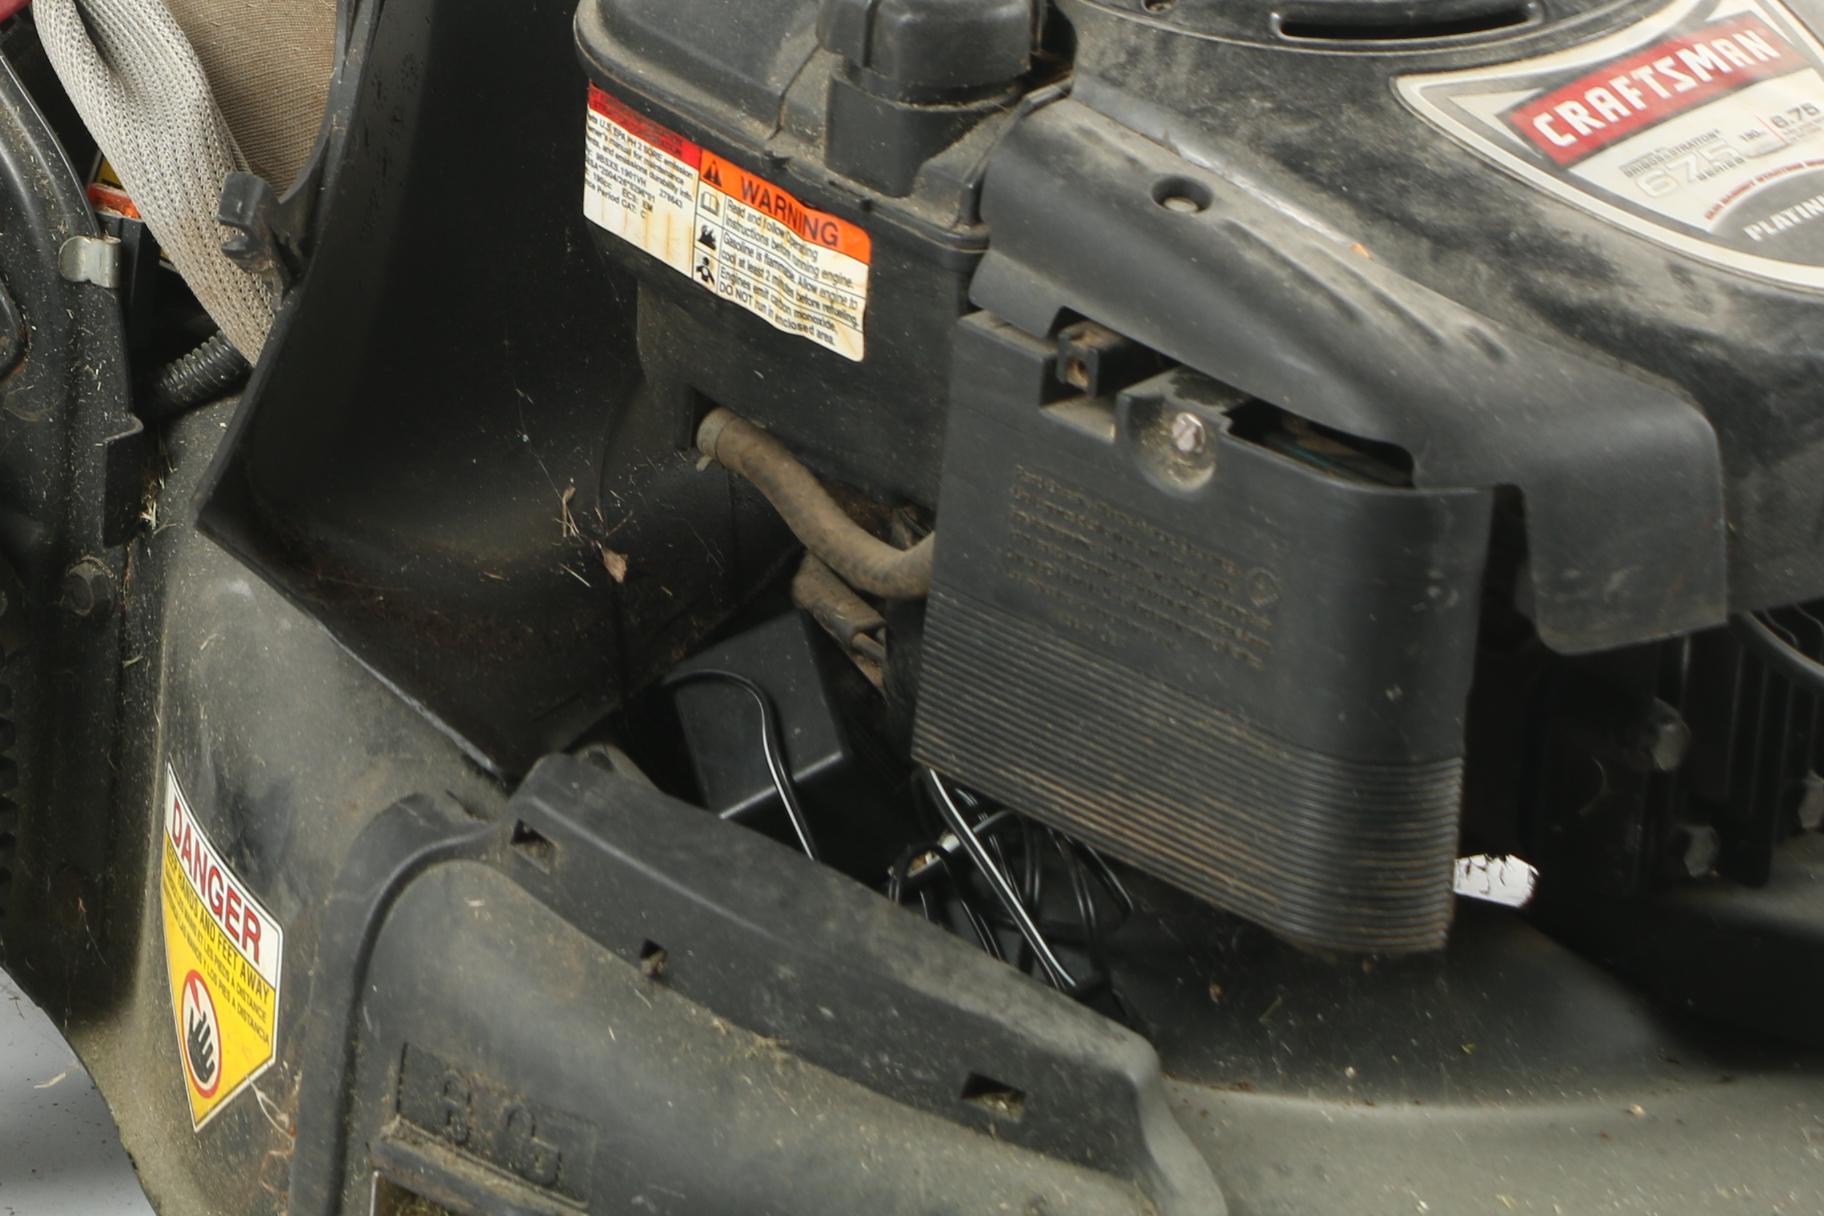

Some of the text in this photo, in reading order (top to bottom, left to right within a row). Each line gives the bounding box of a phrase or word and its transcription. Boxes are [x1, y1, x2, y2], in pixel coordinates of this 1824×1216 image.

[1532, 29, 1782, 148] CRAFTSMAN
[727, 199, 746, 218] Read
[747, 211, 761, 226] and
[762, 219, 785, 237] follow
[742, 176, 839, 246] WARNING
[720, 266, 751, 292] Engines
[753, 282, 769, 299] emit
[770, 294, 791, 316] carbon
[722, 251, 736, 265] cool
[738, 259, 746, 271] at
[747, 263, 764, 278] least
[765, 270, 770, 281] 2
[795, 289, 820, 309] before
[723, 233, 754, 258] Gasoline
[756, 247, 762, 261] is
[798, 276, 818, 297] Allow
[819, 283, 849, 307] engine
[850, 295, 858, 310] to
[719, 282, 733, 297] DO
[735, 290, 753, 306] NOT
[755, 300, 767, 314] run
[775, 313, 816, 336] enclosed
[171, 799, 262, 966] DANGER
[178, 870, 198, 914] HANDS
[200, 907, 216, 941] AND
[217, 931, 238, 969] FEET
[240, 957, 270, 1003] AWAY
[236, 982, 267, 1024] DISTANCE
[237, 1003, 270, 1046] DISTANCIA
